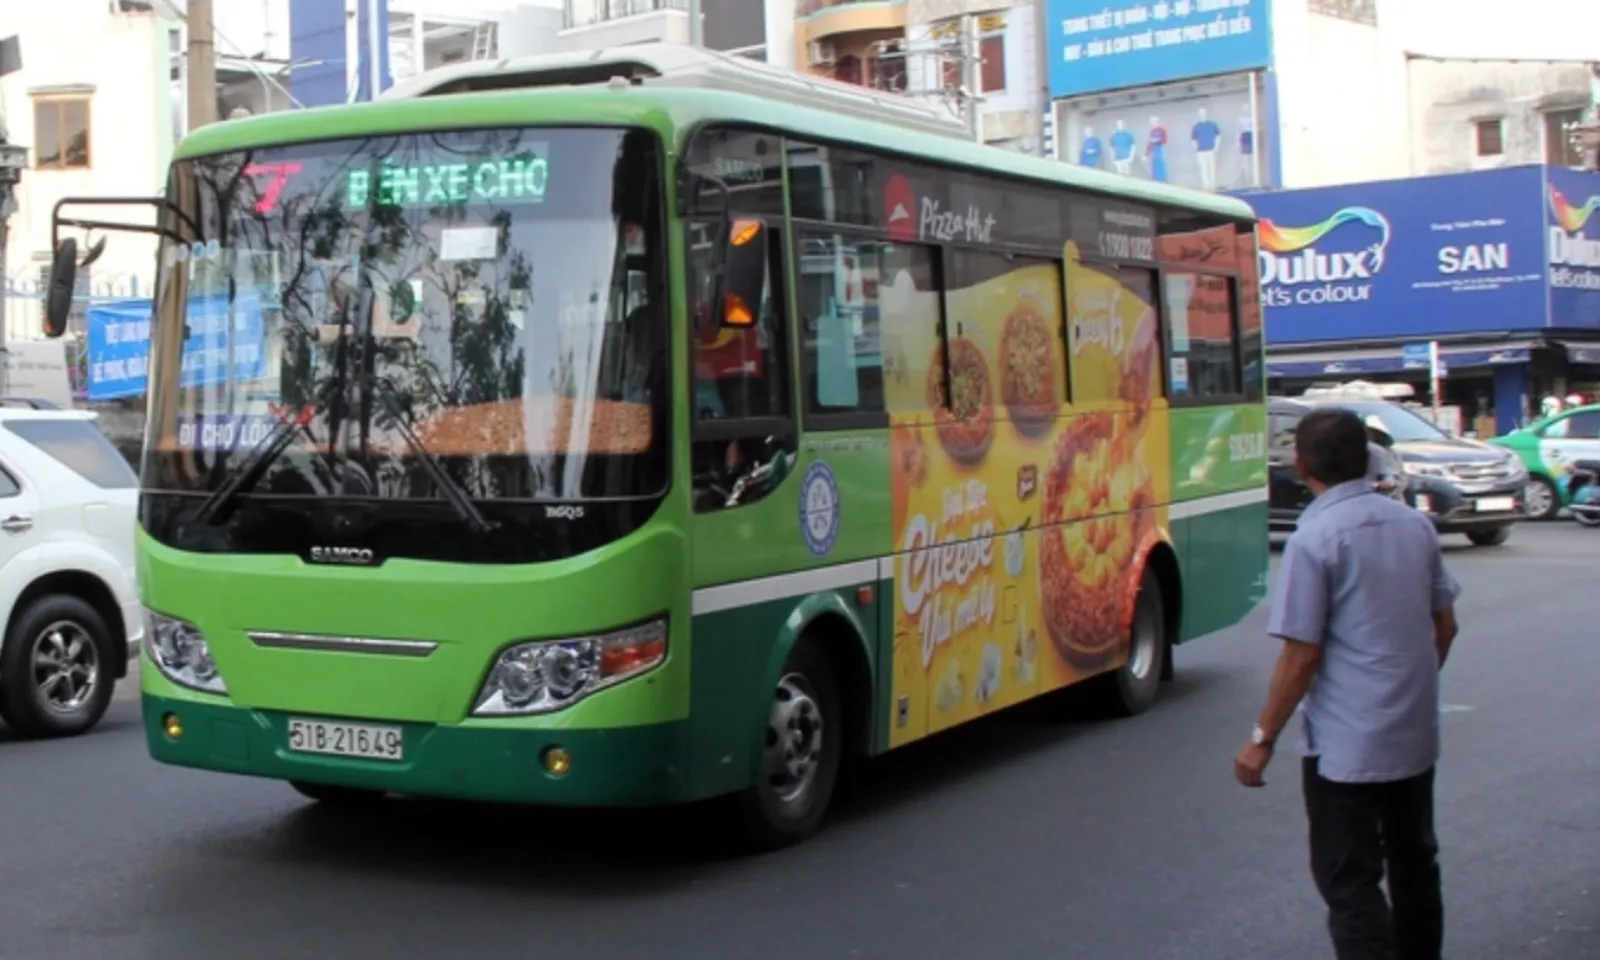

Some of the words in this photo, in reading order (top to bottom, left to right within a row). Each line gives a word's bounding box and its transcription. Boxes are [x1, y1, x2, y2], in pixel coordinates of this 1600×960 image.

[243, 163, 303, 213] 7
[423, 163, 469, 202] XE
[919, 196, 964, 241] Pizza
[964, 203, 997, 244] Hut
[1437, 242, 1509, 274] SAN
[1549, 225, 1600, 268] Dulu
[1295, 282, 1373, 305] colour
[310, 546, 374, 563] SAMCO
[902, 513, 995, 615] Cheese
